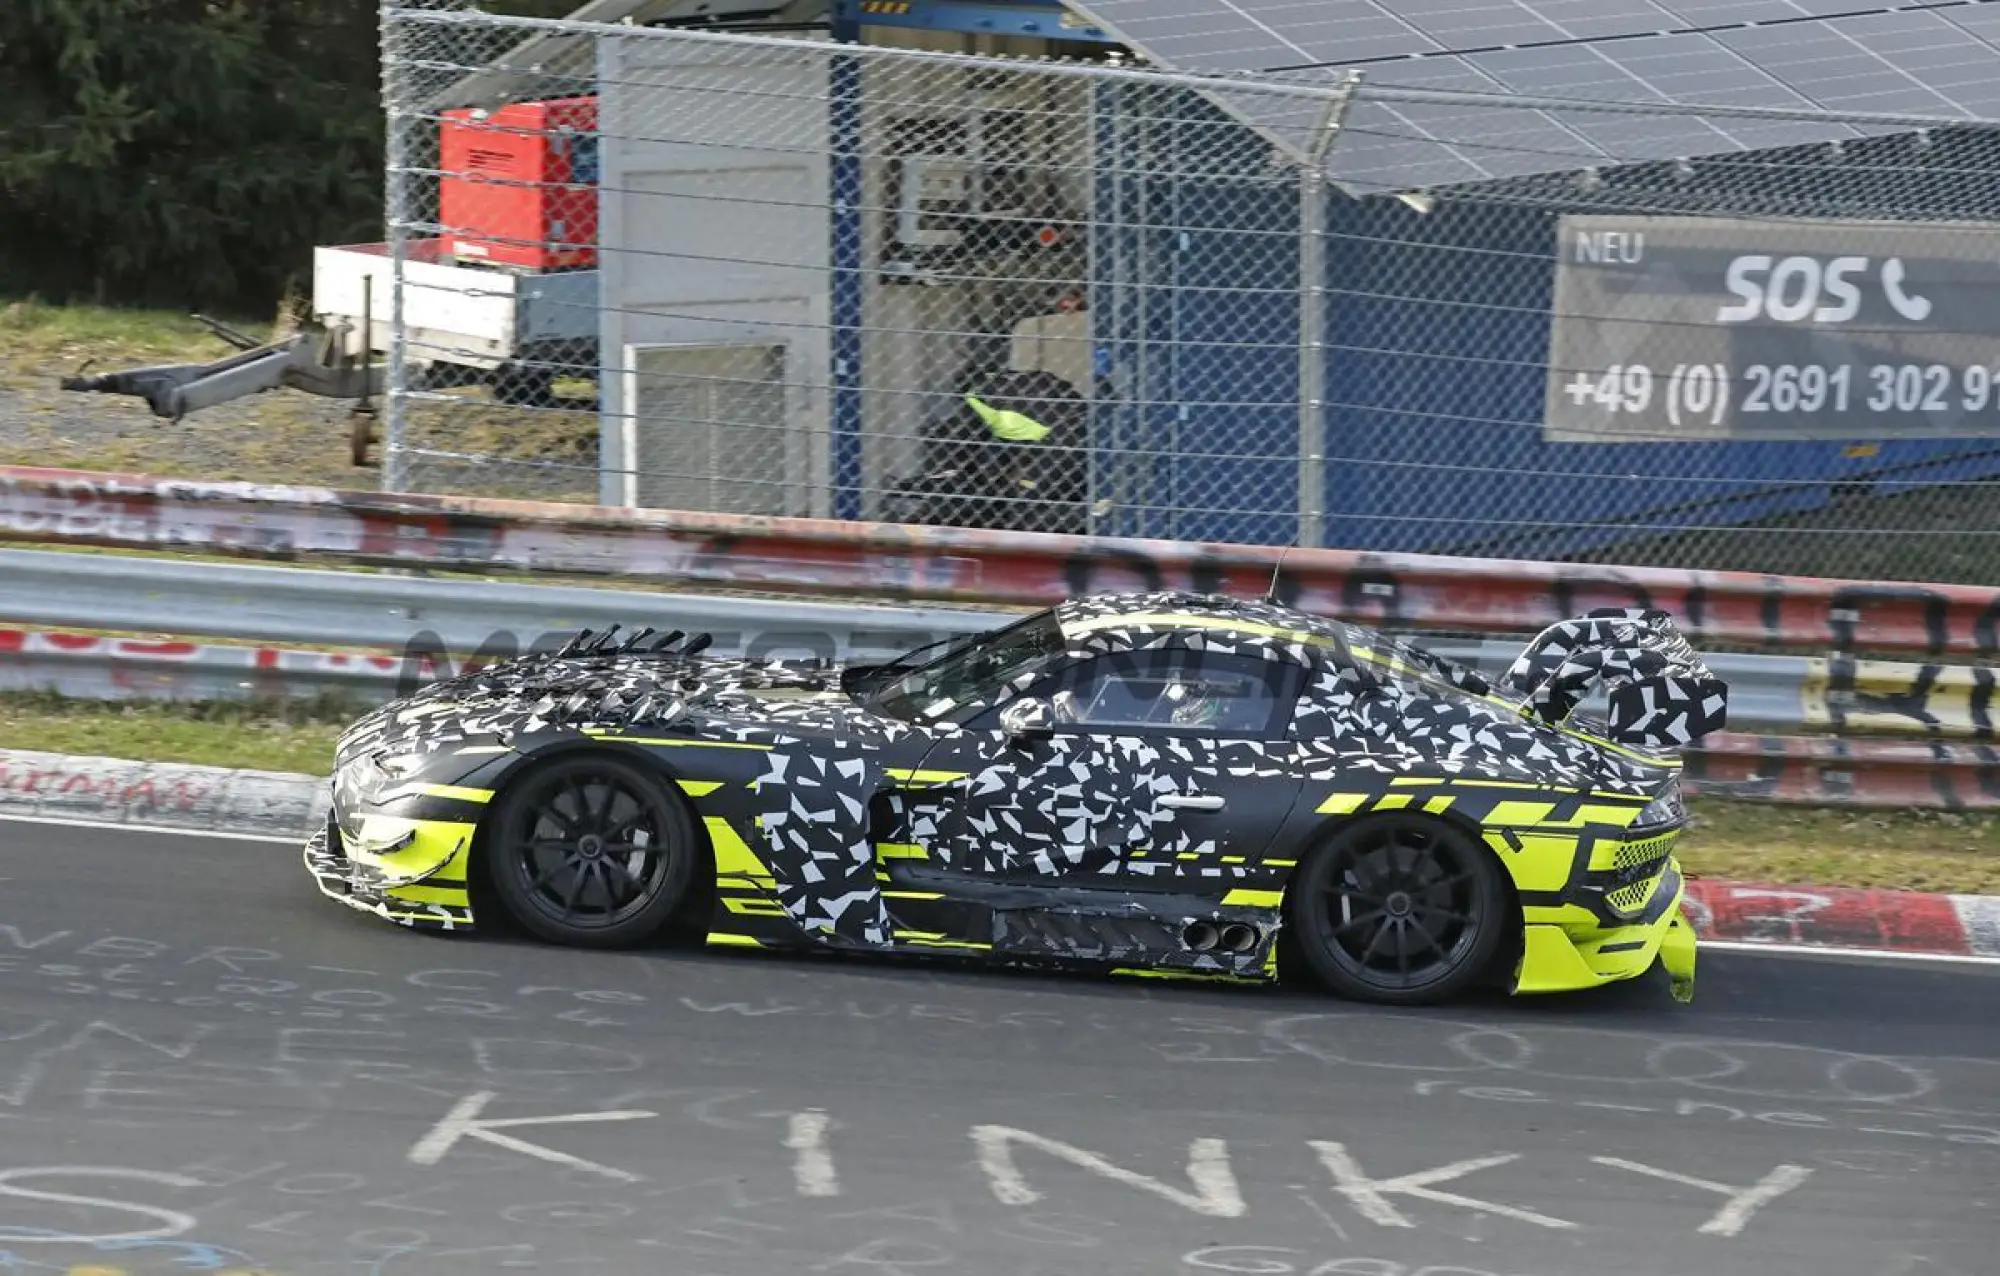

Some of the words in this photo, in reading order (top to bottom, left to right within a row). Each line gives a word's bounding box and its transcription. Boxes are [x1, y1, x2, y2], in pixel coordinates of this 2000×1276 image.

[1575, 231, 1645, 264] NEU
[1717, 255, 1868, 322] SOS
[1564, 364, 1653, 412] +49
[1667, 363, 1730, 425] (0)
[1741, 365, 1850, 411] 2691
[1867, 364, 1949, 411] 302
[408, 1090, 1814, 1237] KINKY
